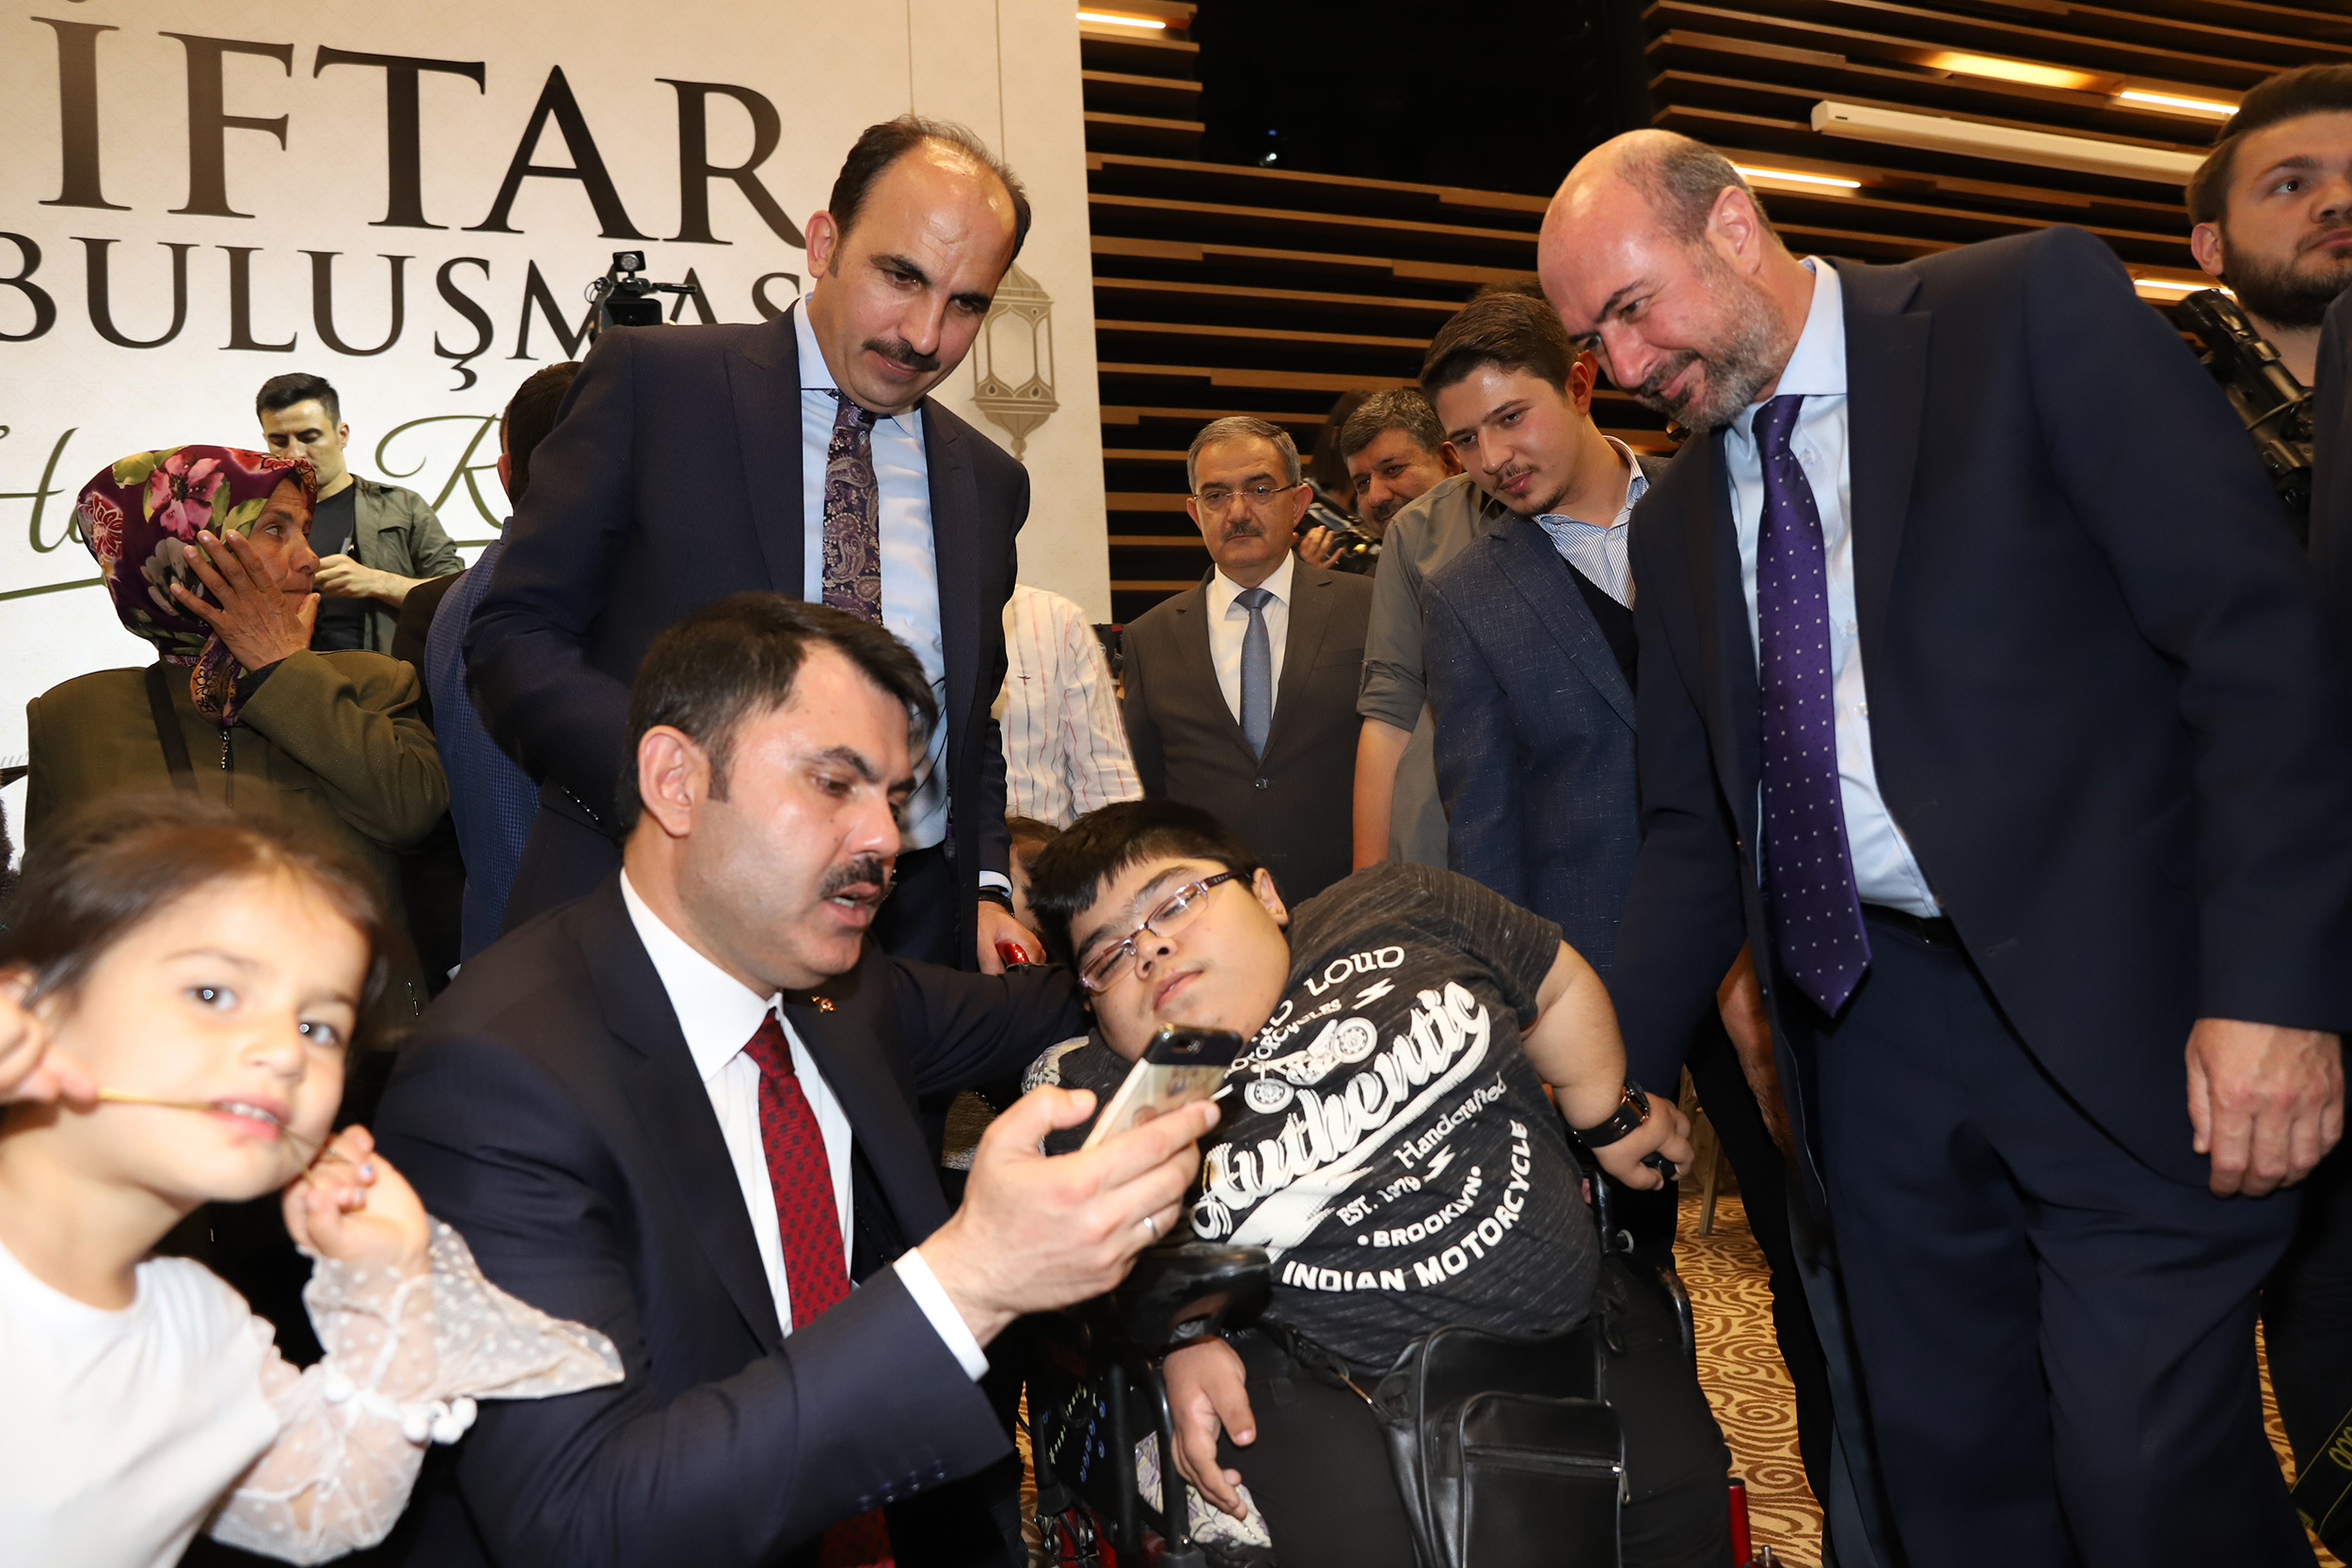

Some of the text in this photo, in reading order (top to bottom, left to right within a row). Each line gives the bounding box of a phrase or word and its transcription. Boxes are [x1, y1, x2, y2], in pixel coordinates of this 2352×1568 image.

[31, 0, 806, 246] İFTAR
[1304, 946, 1405, 996] LOUD
[1223, 998, 1343, 1079] OTORCYCLES
[1190, 981, 1491, 1240] Authentic
[1393, 1071, 1507, 1169] Handcrafted
[1282, 1119, 1532, 1292] INDIAN MOTORCYCLE
[1336, 1195, 1379, 1227] EST.
